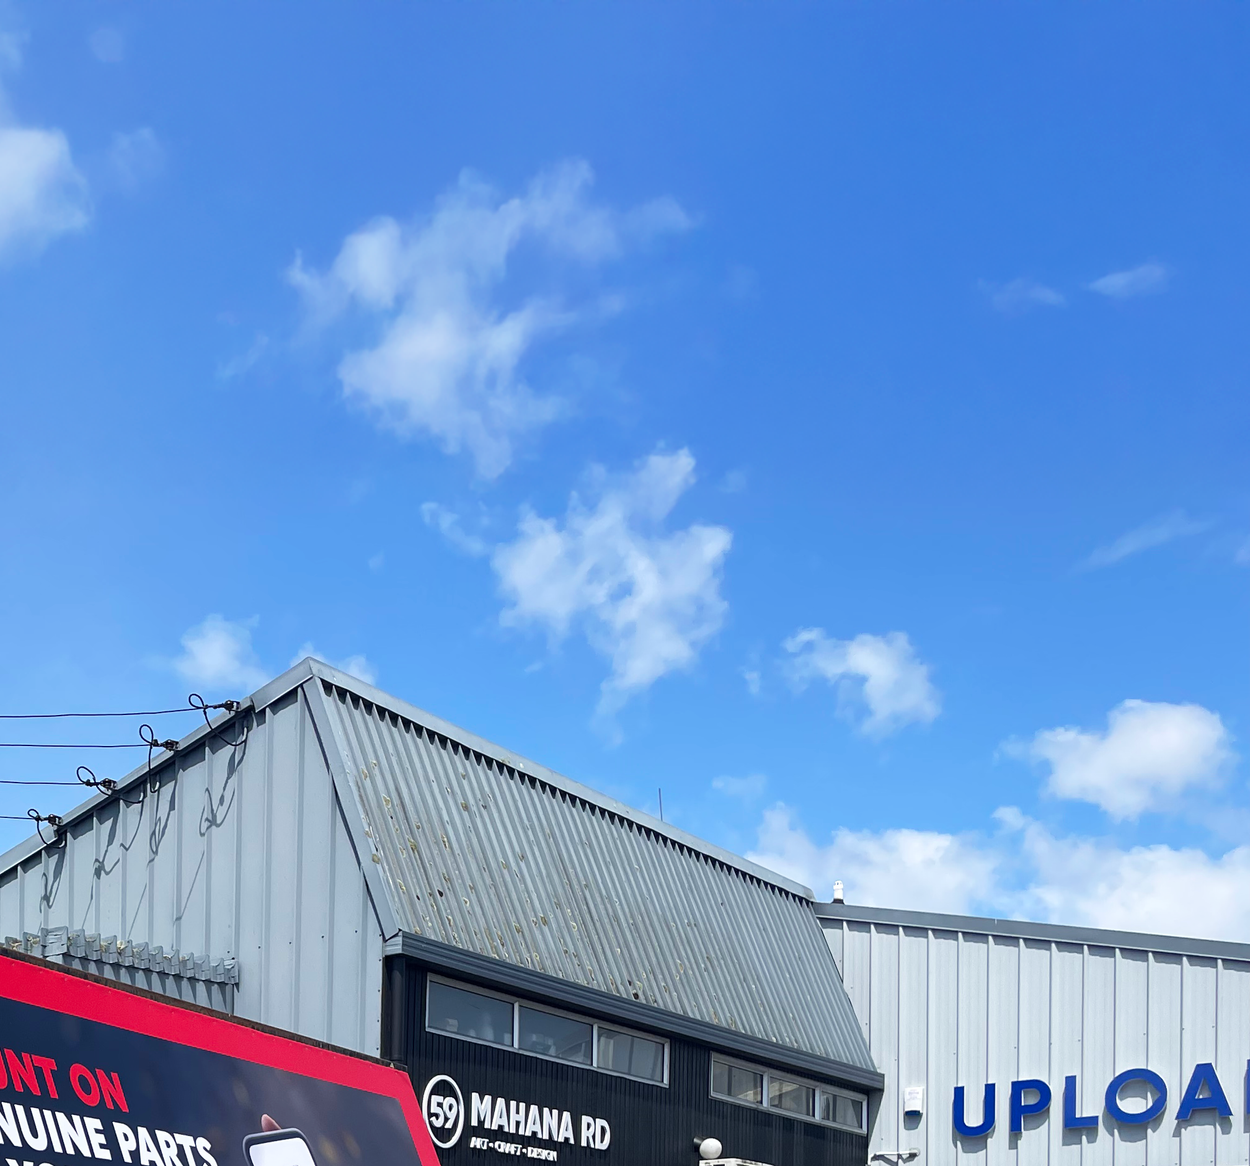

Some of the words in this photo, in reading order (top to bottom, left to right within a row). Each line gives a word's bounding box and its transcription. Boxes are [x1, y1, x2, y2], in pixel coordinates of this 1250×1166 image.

[70, 1063, 129, 1112] ON
[953, 1059, 1250, 1136] UPLOA
[430, 1095, 458, 1129] 59
[471, 1092, 574, 1144] MAHANA
[581, 1115, 611, 1150] RD
[470, 1137, 489, 1149] ART
[494, 1141, 522, 1155] CRAFT
[528, 1147, 557, 1161] DESIGN
